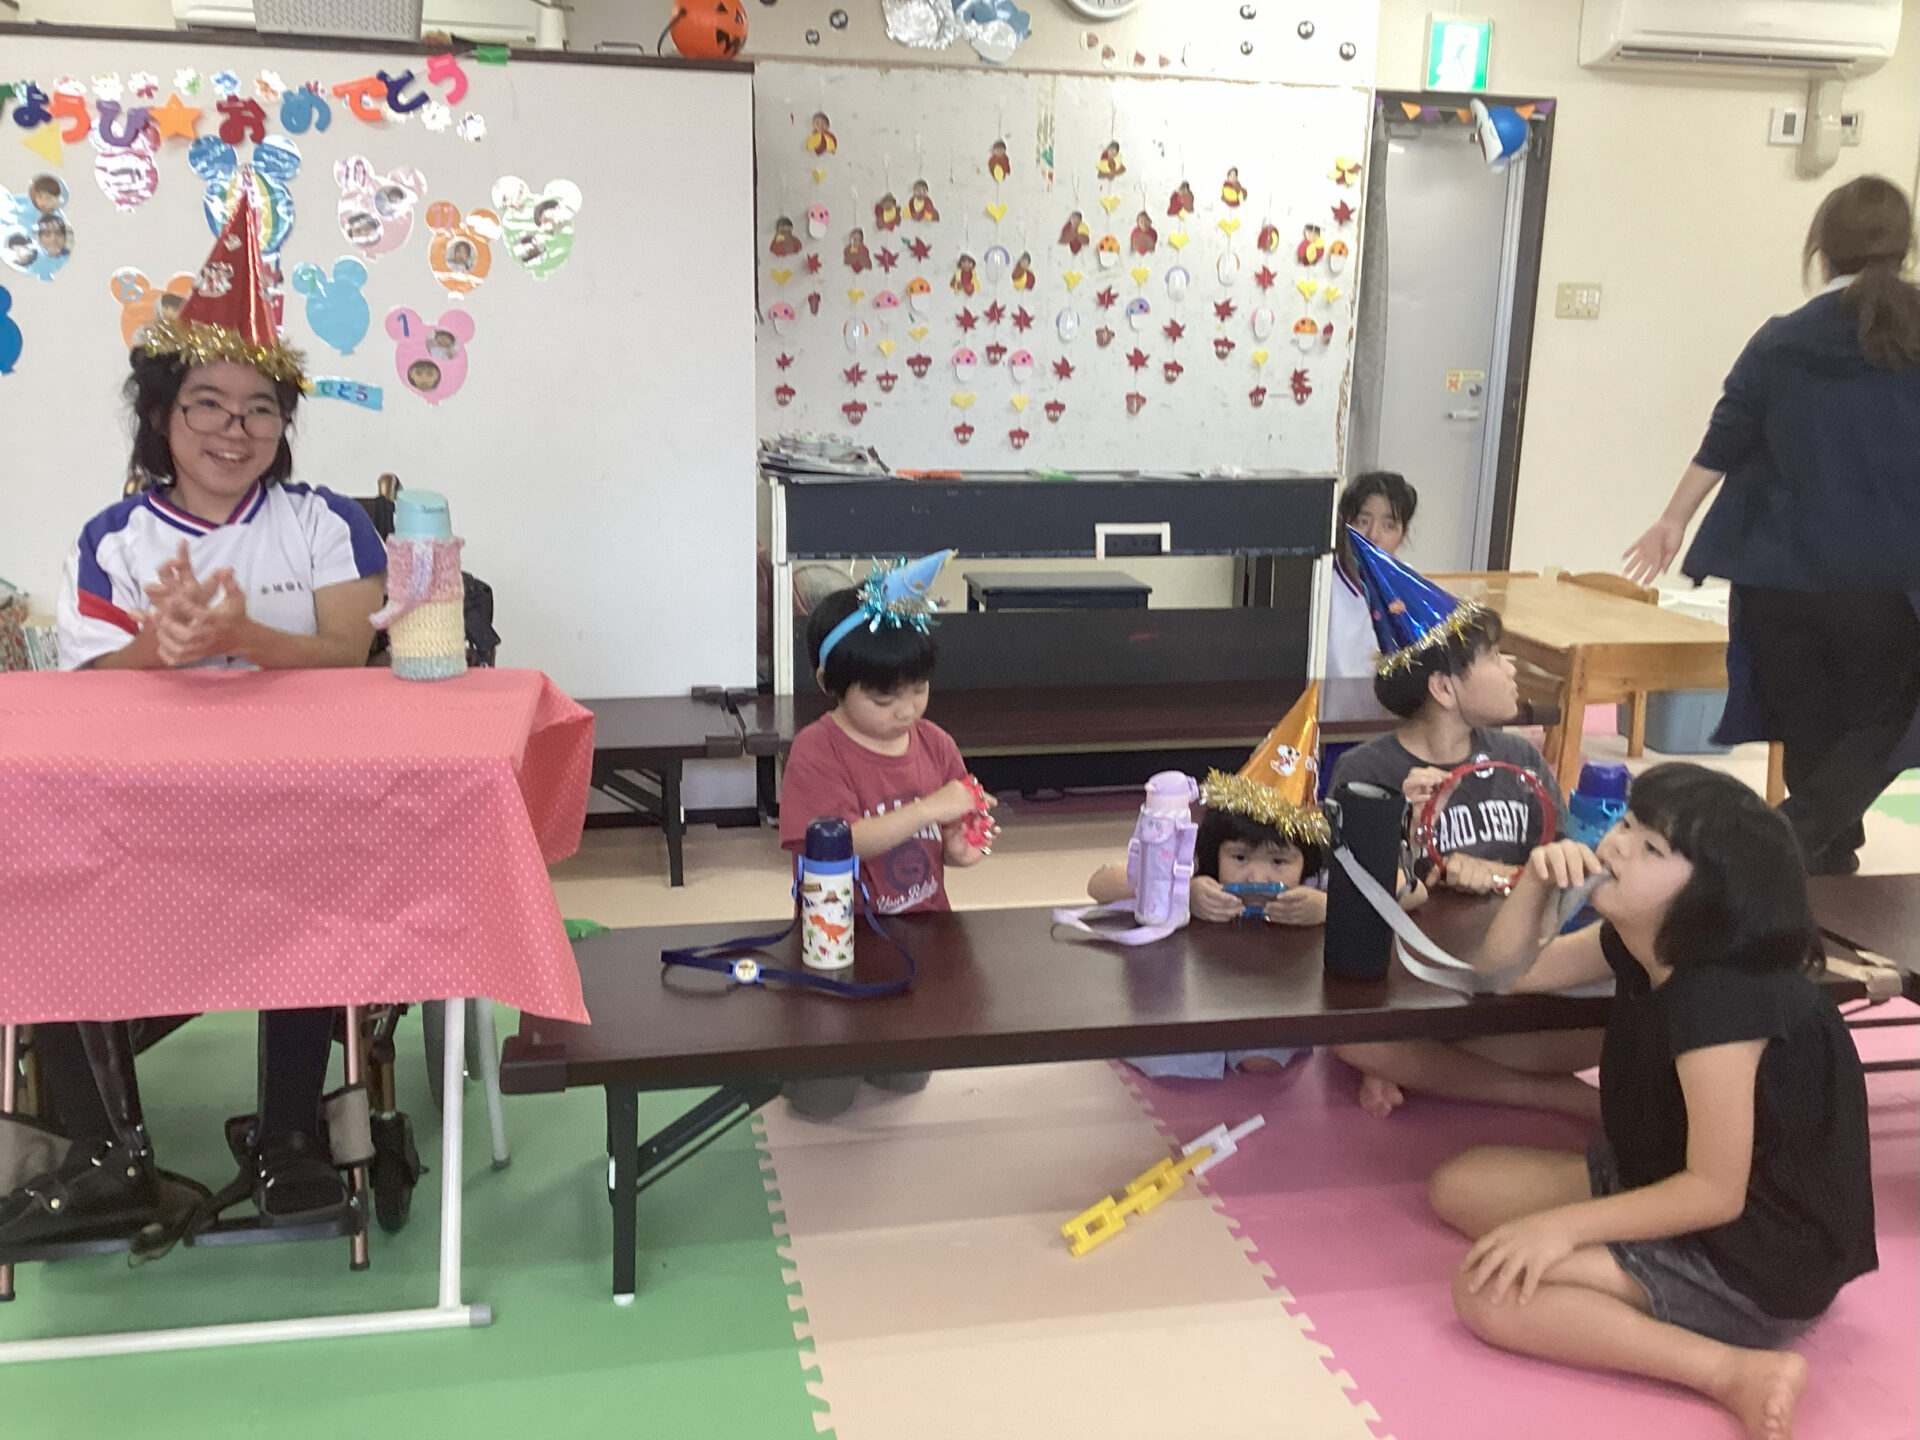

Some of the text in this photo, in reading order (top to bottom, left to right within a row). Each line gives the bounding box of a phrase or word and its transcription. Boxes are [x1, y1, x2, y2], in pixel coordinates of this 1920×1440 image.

[117, 271, 144, 302] 8
[396, 311, 410, 338] 1
[1439, 803, 1477, 854] AND
